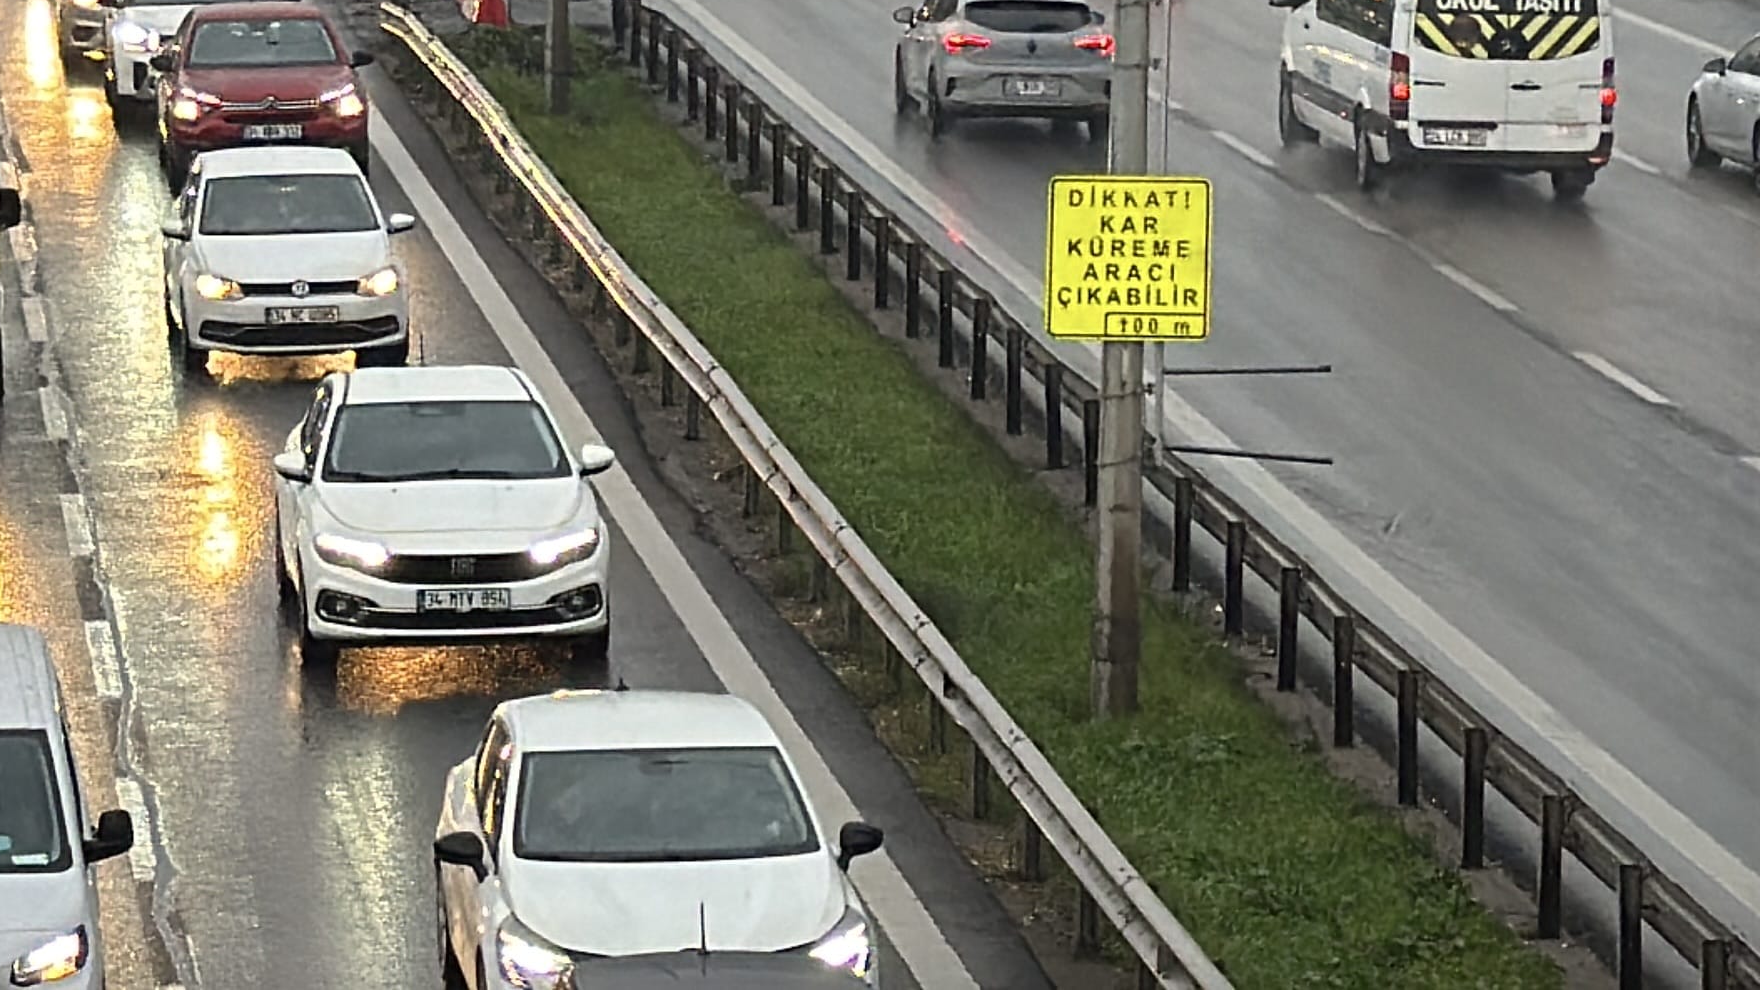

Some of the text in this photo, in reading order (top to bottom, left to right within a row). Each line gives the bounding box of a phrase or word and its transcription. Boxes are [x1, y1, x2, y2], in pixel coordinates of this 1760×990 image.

[1068, 185, 1191, 210] DİKKAT!
[1100, 215, 1159, 235] KAR
[1067, 236, 1191, 259] KÜREME
[1083, 263, 1175, 283] ARACI
[1057, 283, 1199, 309] ÇIKABİLİR
[1119, 317, 1191, 335] 100 m
